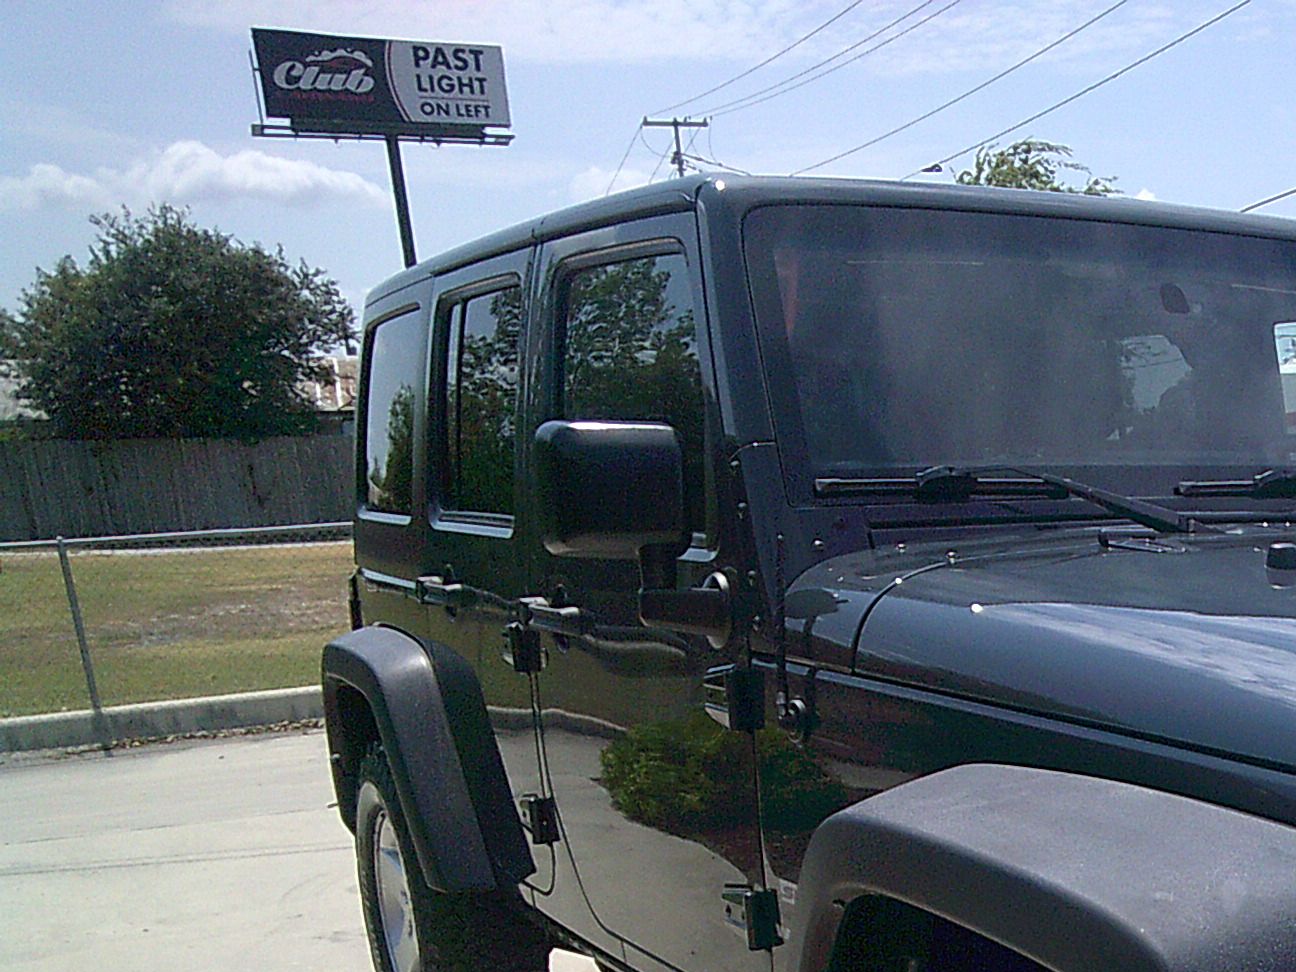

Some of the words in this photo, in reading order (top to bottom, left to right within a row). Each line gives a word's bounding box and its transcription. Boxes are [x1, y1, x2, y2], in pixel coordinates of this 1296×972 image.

[412, 45, 484, 72] PAST
[273, 60, 375, 94] Club
[415, 74, 487, 96] LIGHT
[420, 101, 449, 117] ON
[456, 103, 491, 119] LEFT
